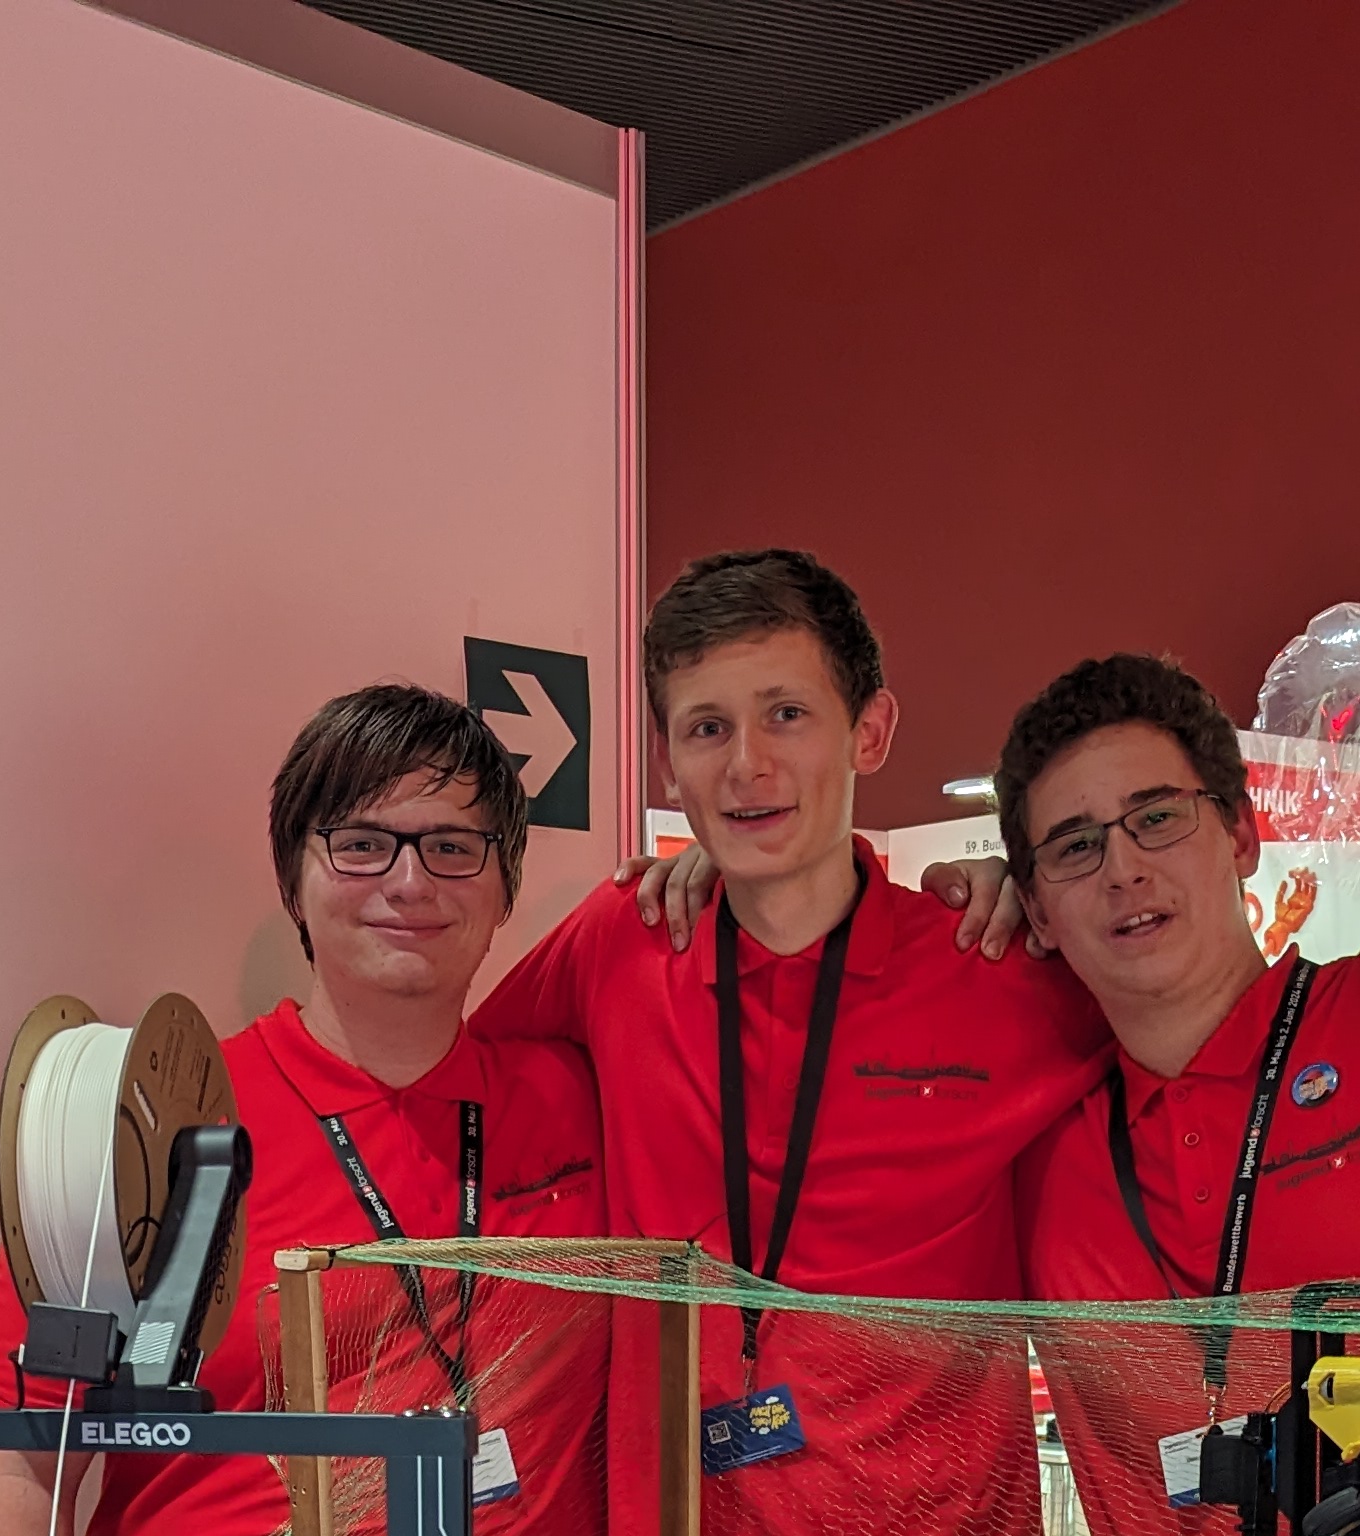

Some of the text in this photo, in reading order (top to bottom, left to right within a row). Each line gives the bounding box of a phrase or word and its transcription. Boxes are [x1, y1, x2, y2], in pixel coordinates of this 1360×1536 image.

[1251, 786, 1301, 815] HNIK
[966, 841, 980, 854] 59.
[1288, 989, 1301, 1008] 2024
[1283, 1007, 1296, 1026] Juni
[1279, 1026, 1290, 1034] 2.
[1275, 1035, 1287, 1047] bis
[1270, 1048, 1282, 1064] Mai
[1266, 1066, 1277, 1080] 30.
[337, 1132, 348, 1146] 30.
[347, 1157, 368, 1187] forscht
[1223, 1094, 1269, 1292] Bundeswettbewerb jugend forscht
[365, 1192, 394, 1229] jugend
[82, 1421, 191, 1447] ELEGOO
